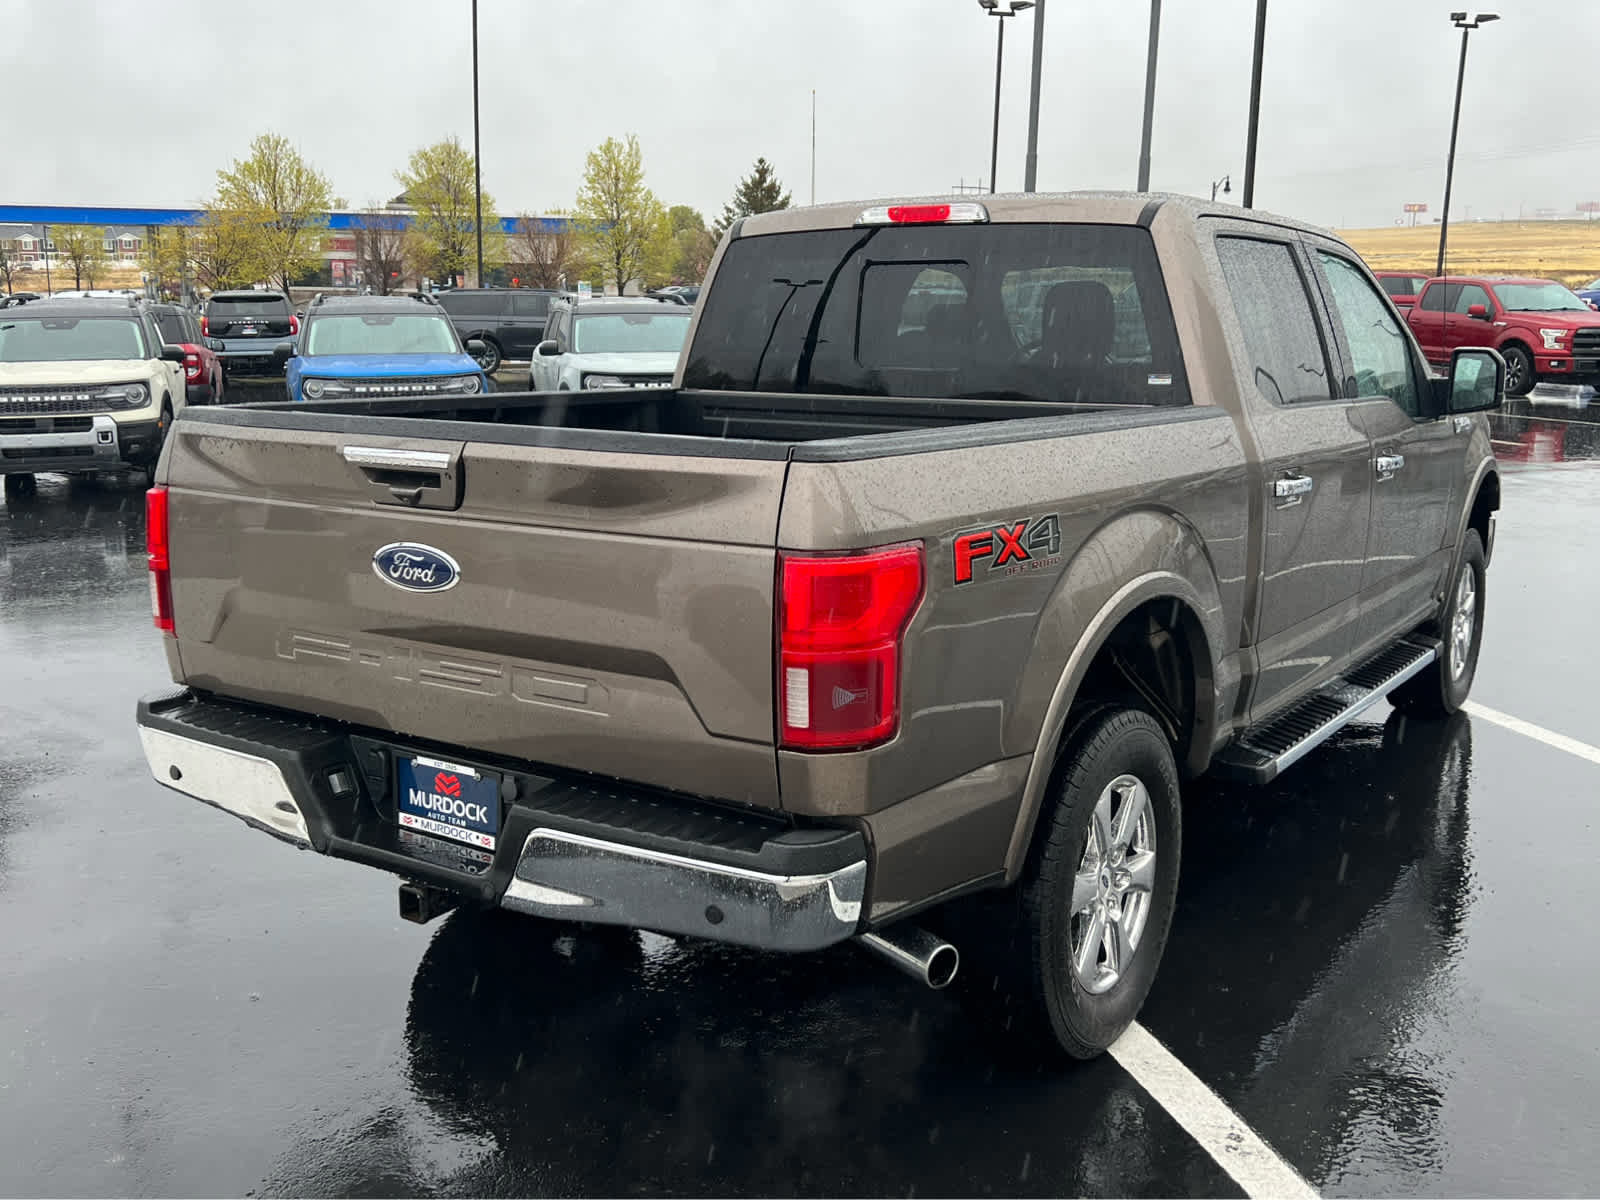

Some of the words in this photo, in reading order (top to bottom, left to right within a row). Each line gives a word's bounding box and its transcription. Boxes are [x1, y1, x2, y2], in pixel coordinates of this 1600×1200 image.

[952, 512, 1062, 587] FX4
[389, 552, 437, 583] Ford
[409, 788, 488, 824] MURDOCK
[427, 811, 446, 822] AUTO
[448, 816, 467, 827] TEAM
[420, 820, 473, 842] MURDOCK
